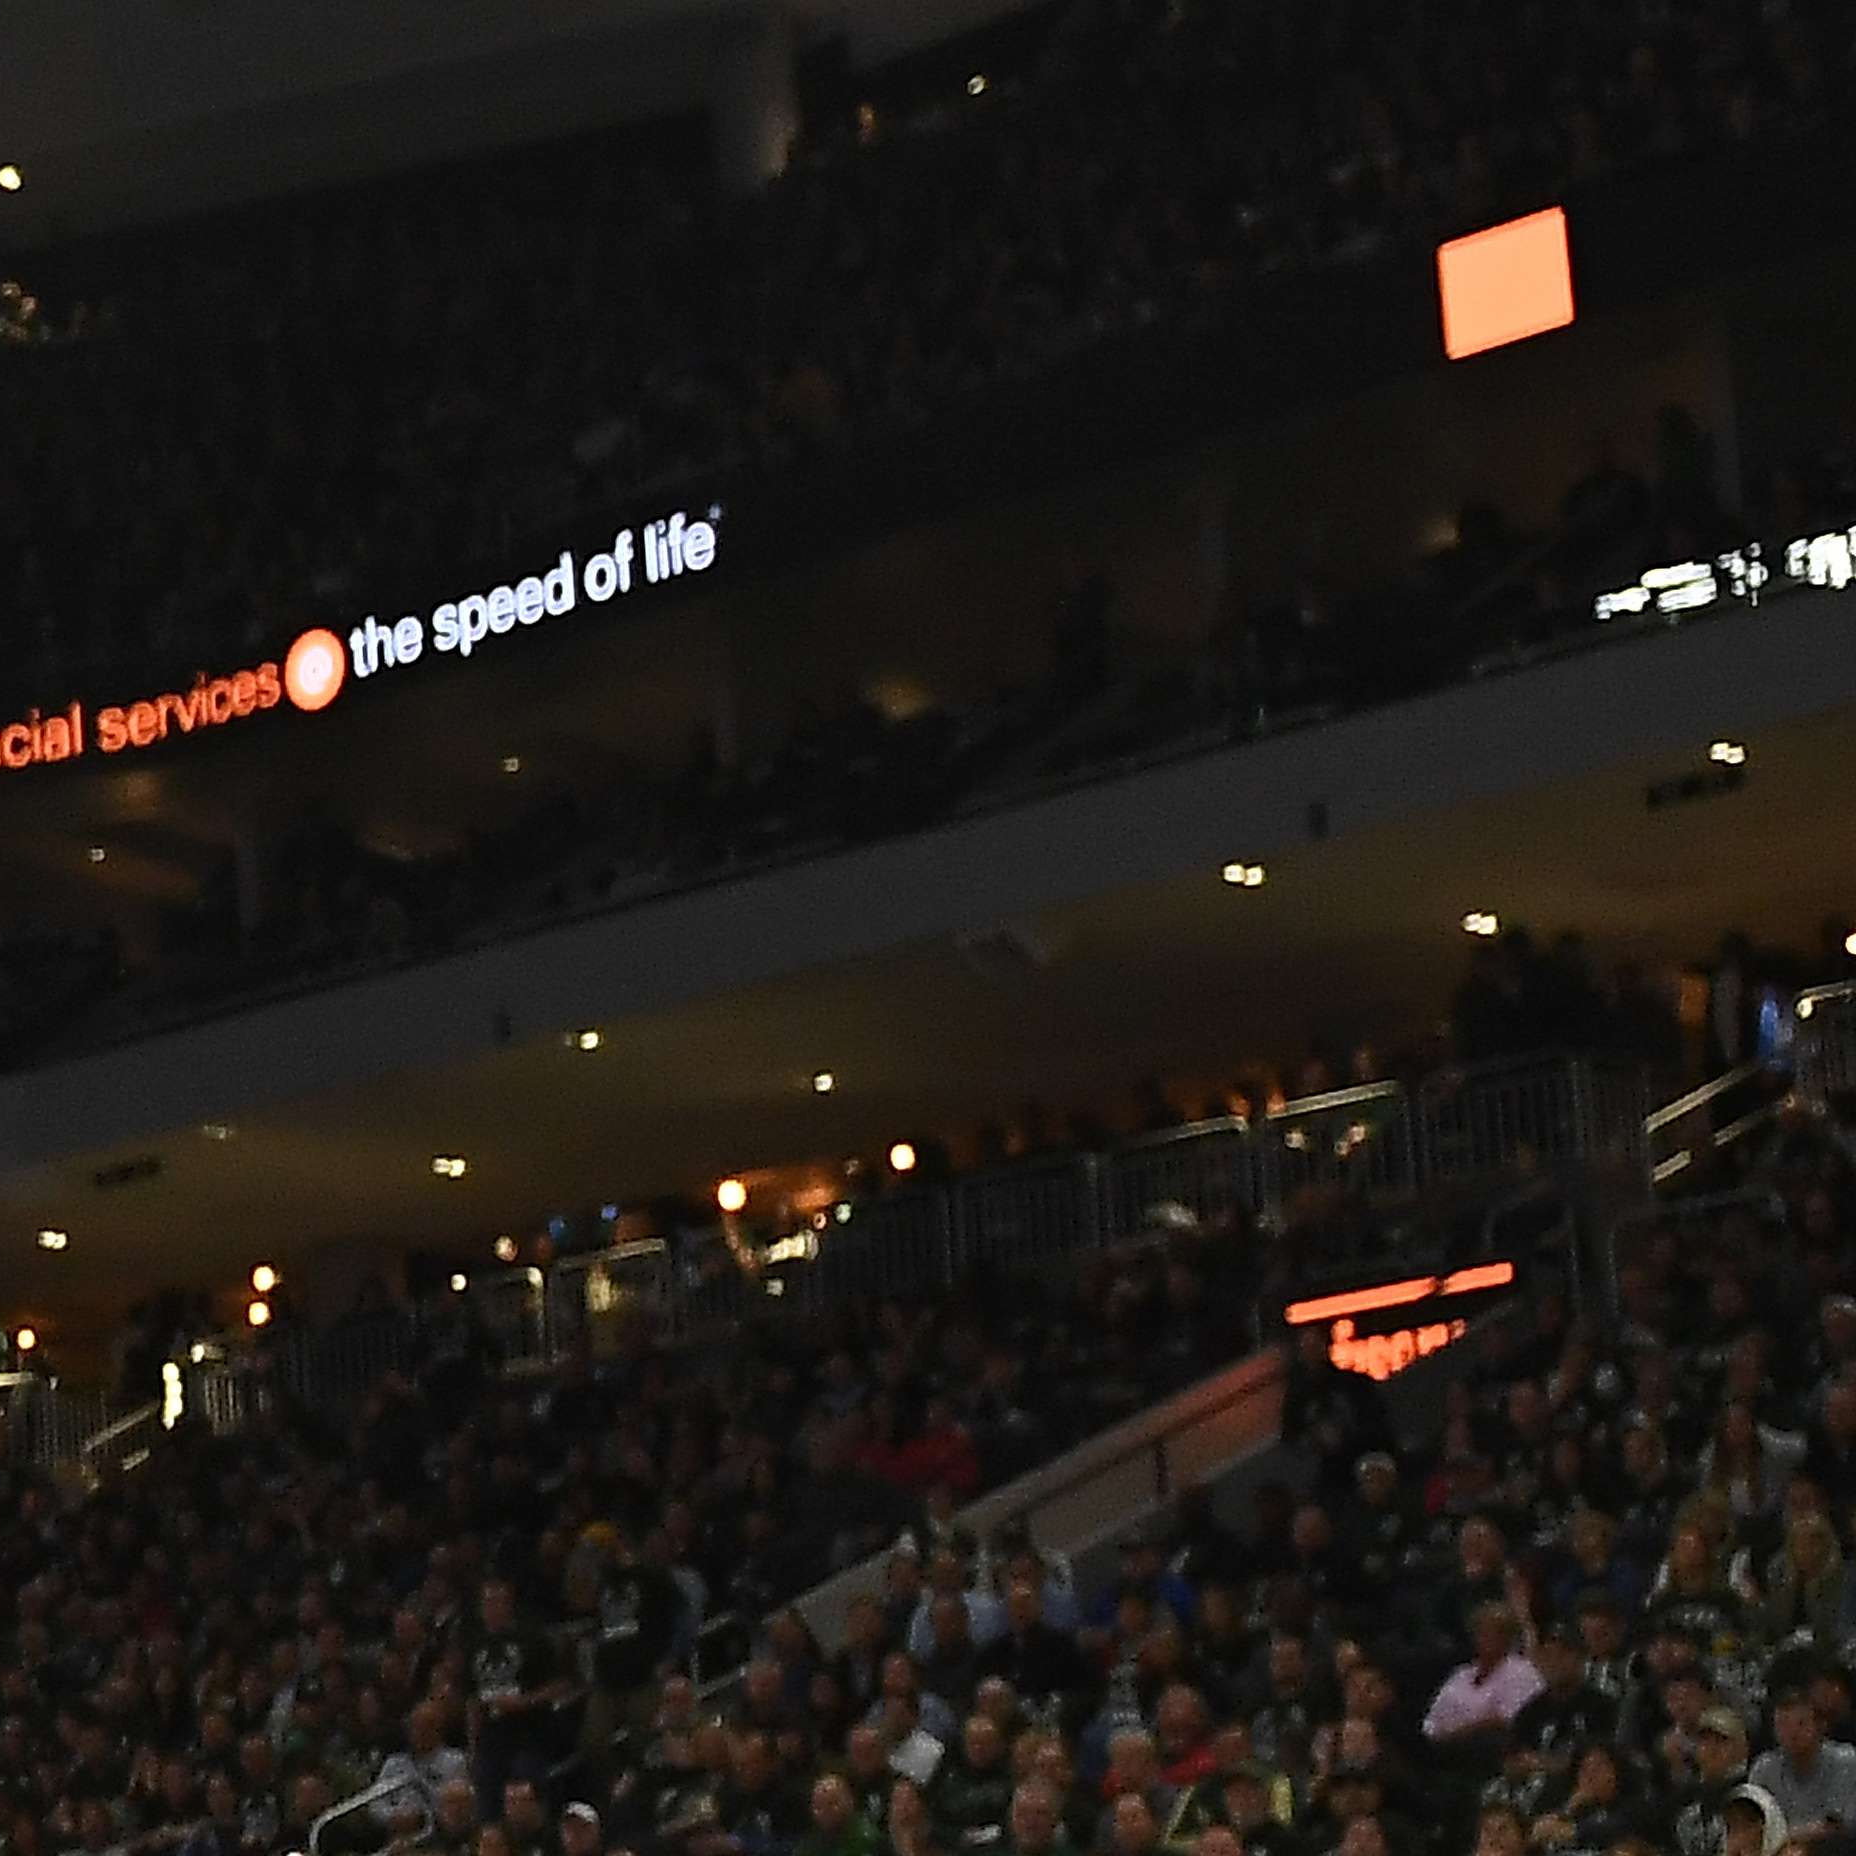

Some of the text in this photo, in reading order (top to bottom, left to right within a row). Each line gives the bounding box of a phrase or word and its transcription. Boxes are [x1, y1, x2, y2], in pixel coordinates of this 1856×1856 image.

[96, 662, 283, 753] services
[349, 615, 424, 678] the
[432, 551, 576, 657] speed
[583, 529, 635, 602] of
[643, 509, 716, 583] life
